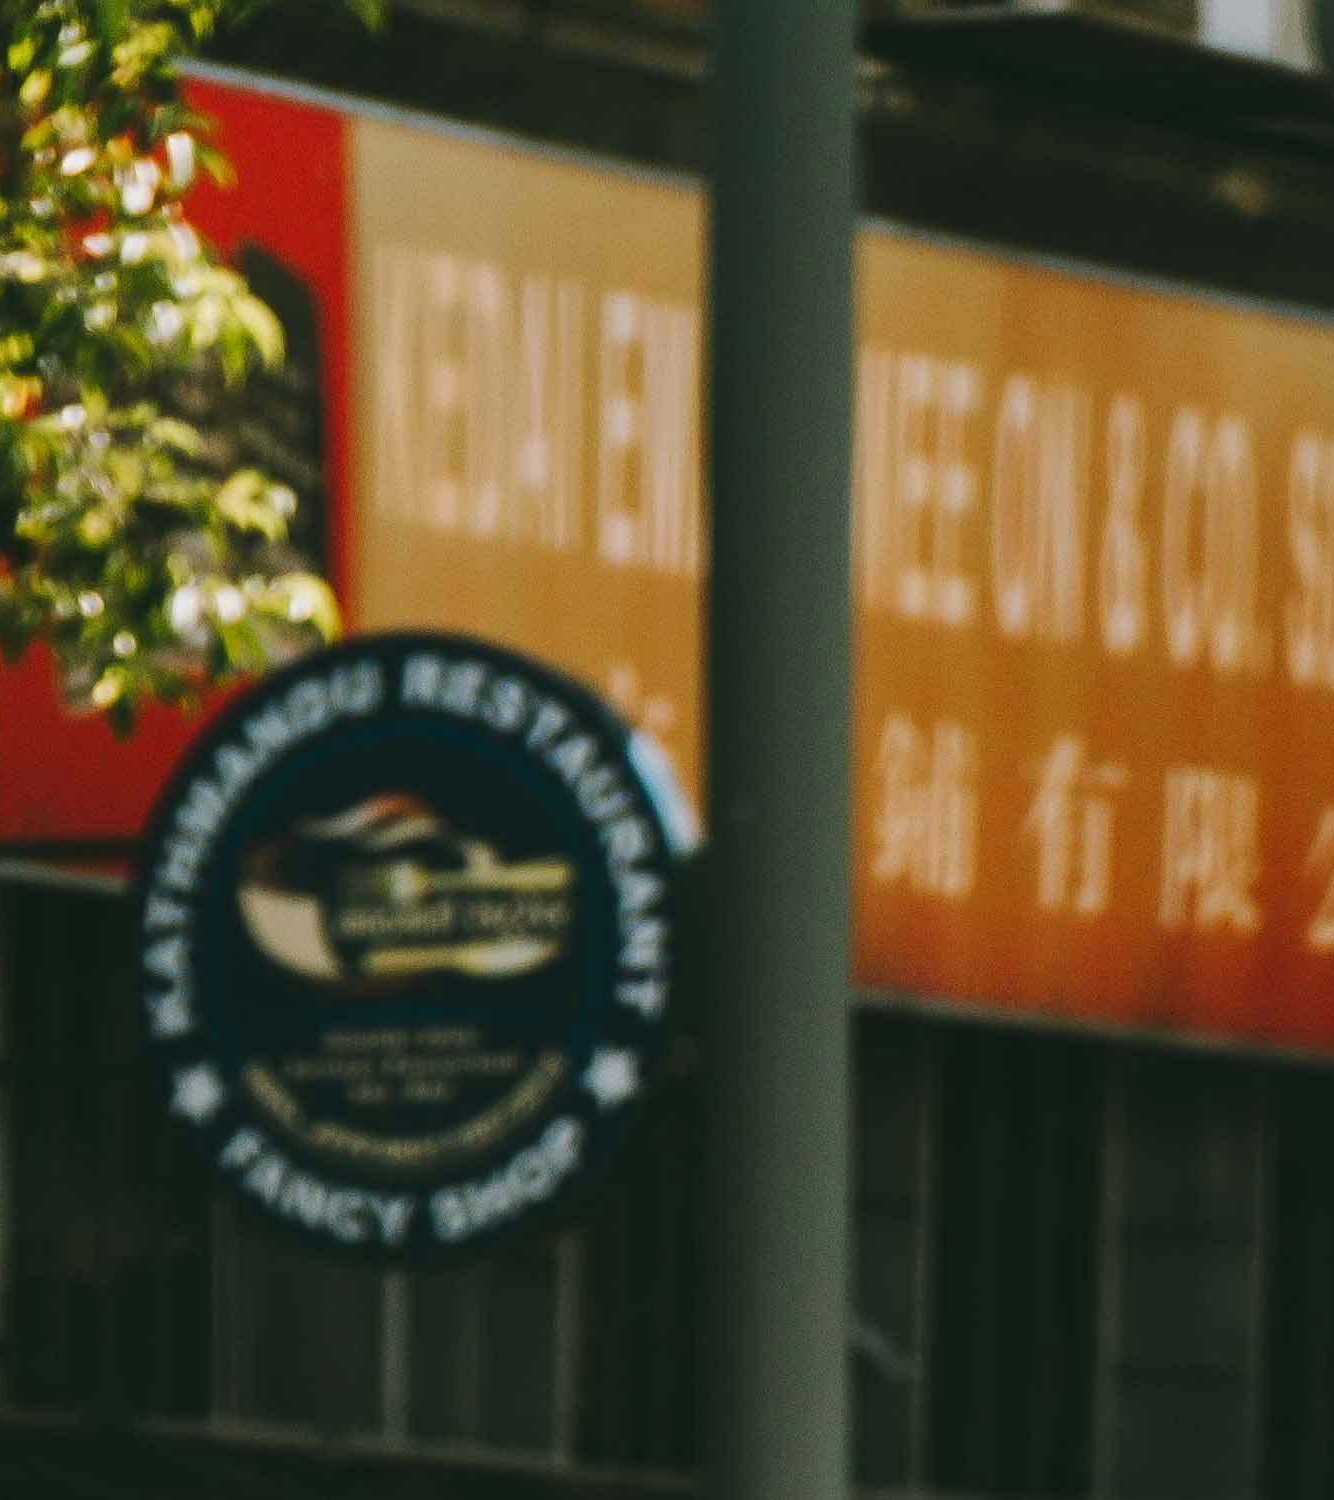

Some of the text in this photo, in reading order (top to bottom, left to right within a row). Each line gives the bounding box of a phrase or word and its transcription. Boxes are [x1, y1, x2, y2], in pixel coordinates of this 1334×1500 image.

[399, 652, 669, 1020] RESTAURANT
[218, 1115, 585, 1244] FANCY SHOP
